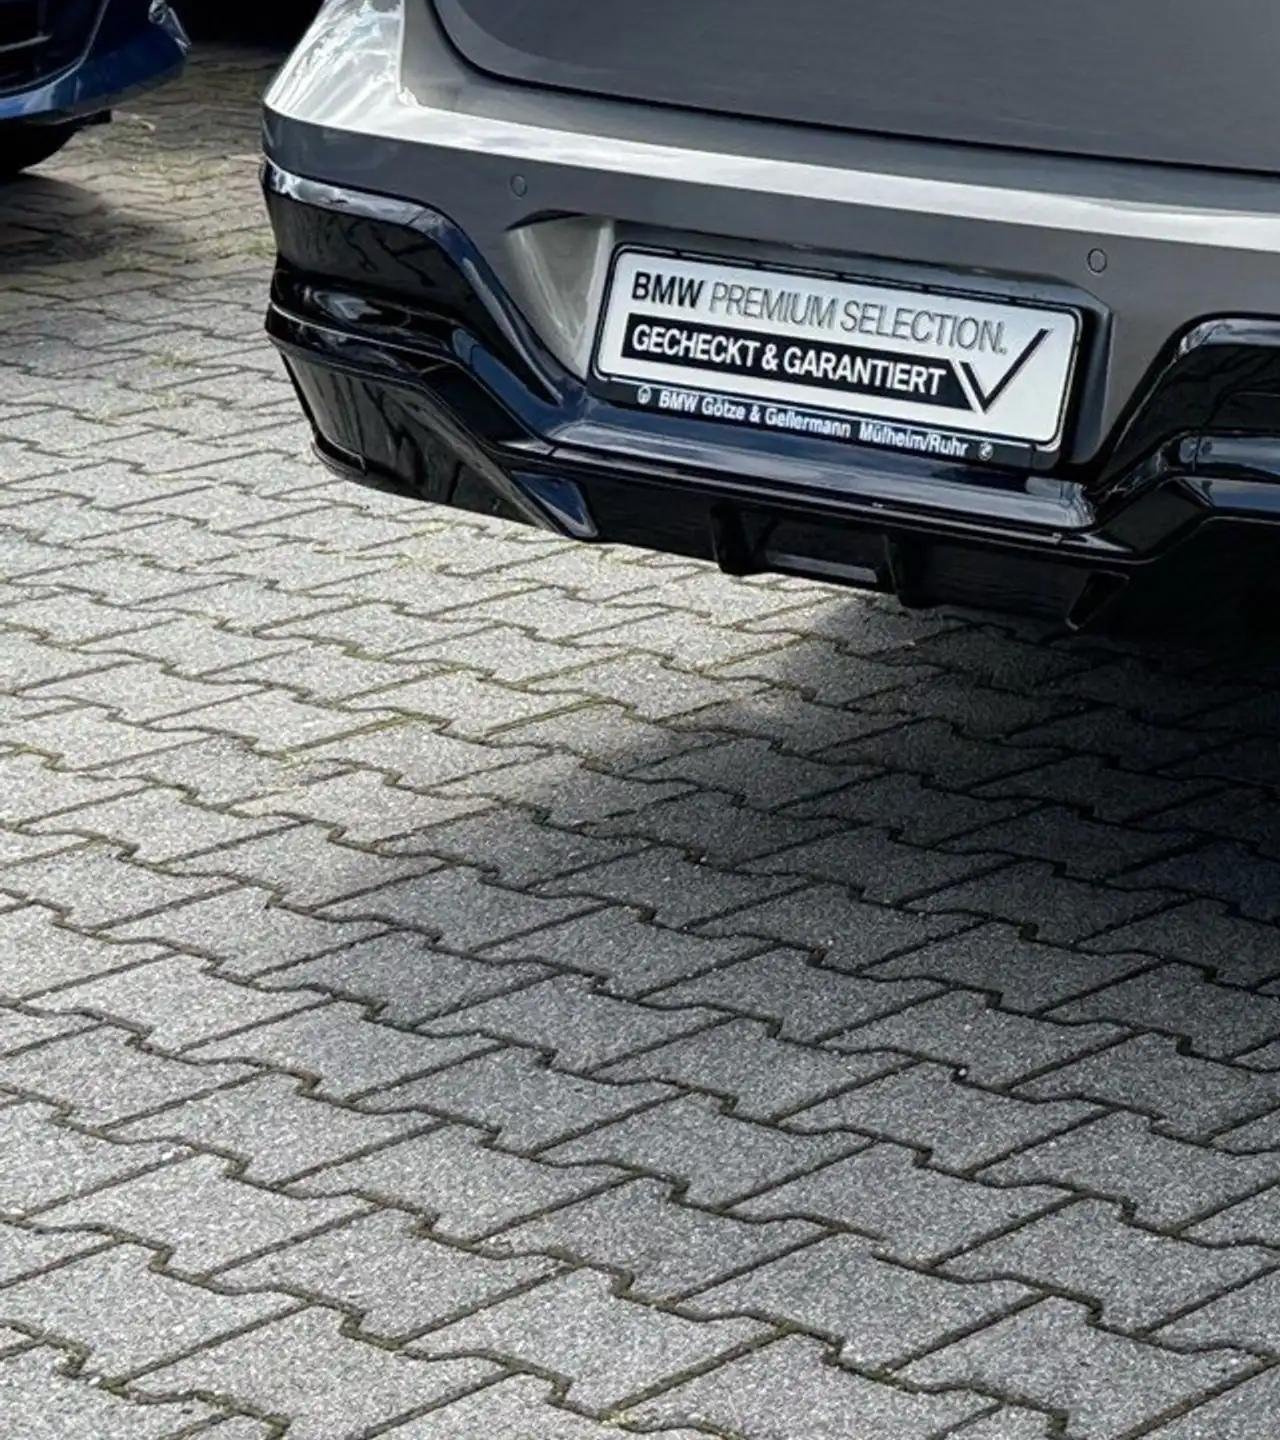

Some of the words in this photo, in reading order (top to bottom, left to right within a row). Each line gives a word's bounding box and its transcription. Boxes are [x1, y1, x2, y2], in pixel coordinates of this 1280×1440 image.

[631, 271, 705, 310] BMW
[708, 282, 839, 330] PREMIUM
[632, 324, 760, 368] GECHECKT
[761, 344, 778, 372] &
[783, 346, 947, 396] GARANTIERT
[658, 391, 699, 412] BMW
[701, 397, 746, 421] Götze
[749, 404, 761, 423] &
[764, 408, 851, 439] Gellermann
[858, 420, 970, 457] Mülheim/Ruhr
